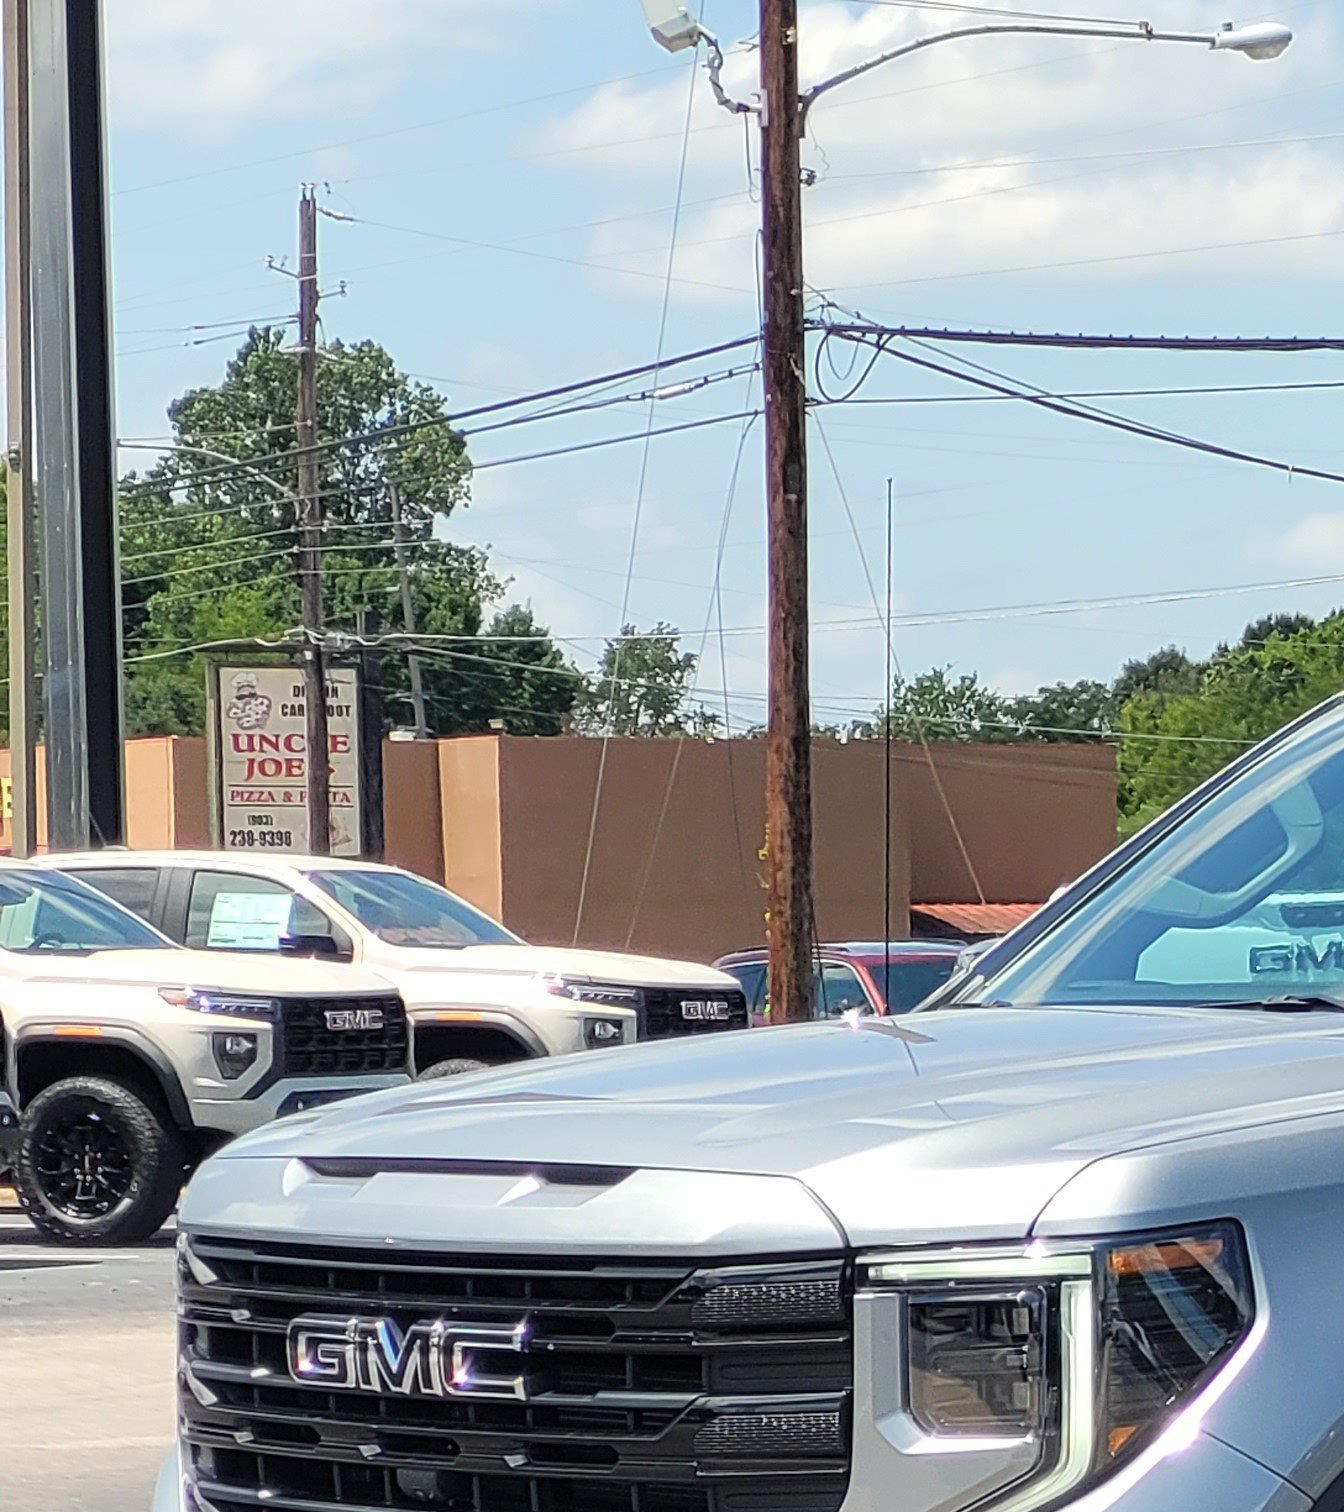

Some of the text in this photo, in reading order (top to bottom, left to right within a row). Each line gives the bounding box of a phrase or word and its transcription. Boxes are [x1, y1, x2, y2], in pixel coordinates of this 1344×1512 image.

[231, 733, 352, 754] UNCE
[244, 757, 336, 782] JOE
[230, 790, 352, 804] PIZZA & PTA
[323, 1009, 384, 1031] GMC
[679, 1000, 730, 1020] GMC
[286, 1312, 530, 1401] GMC
